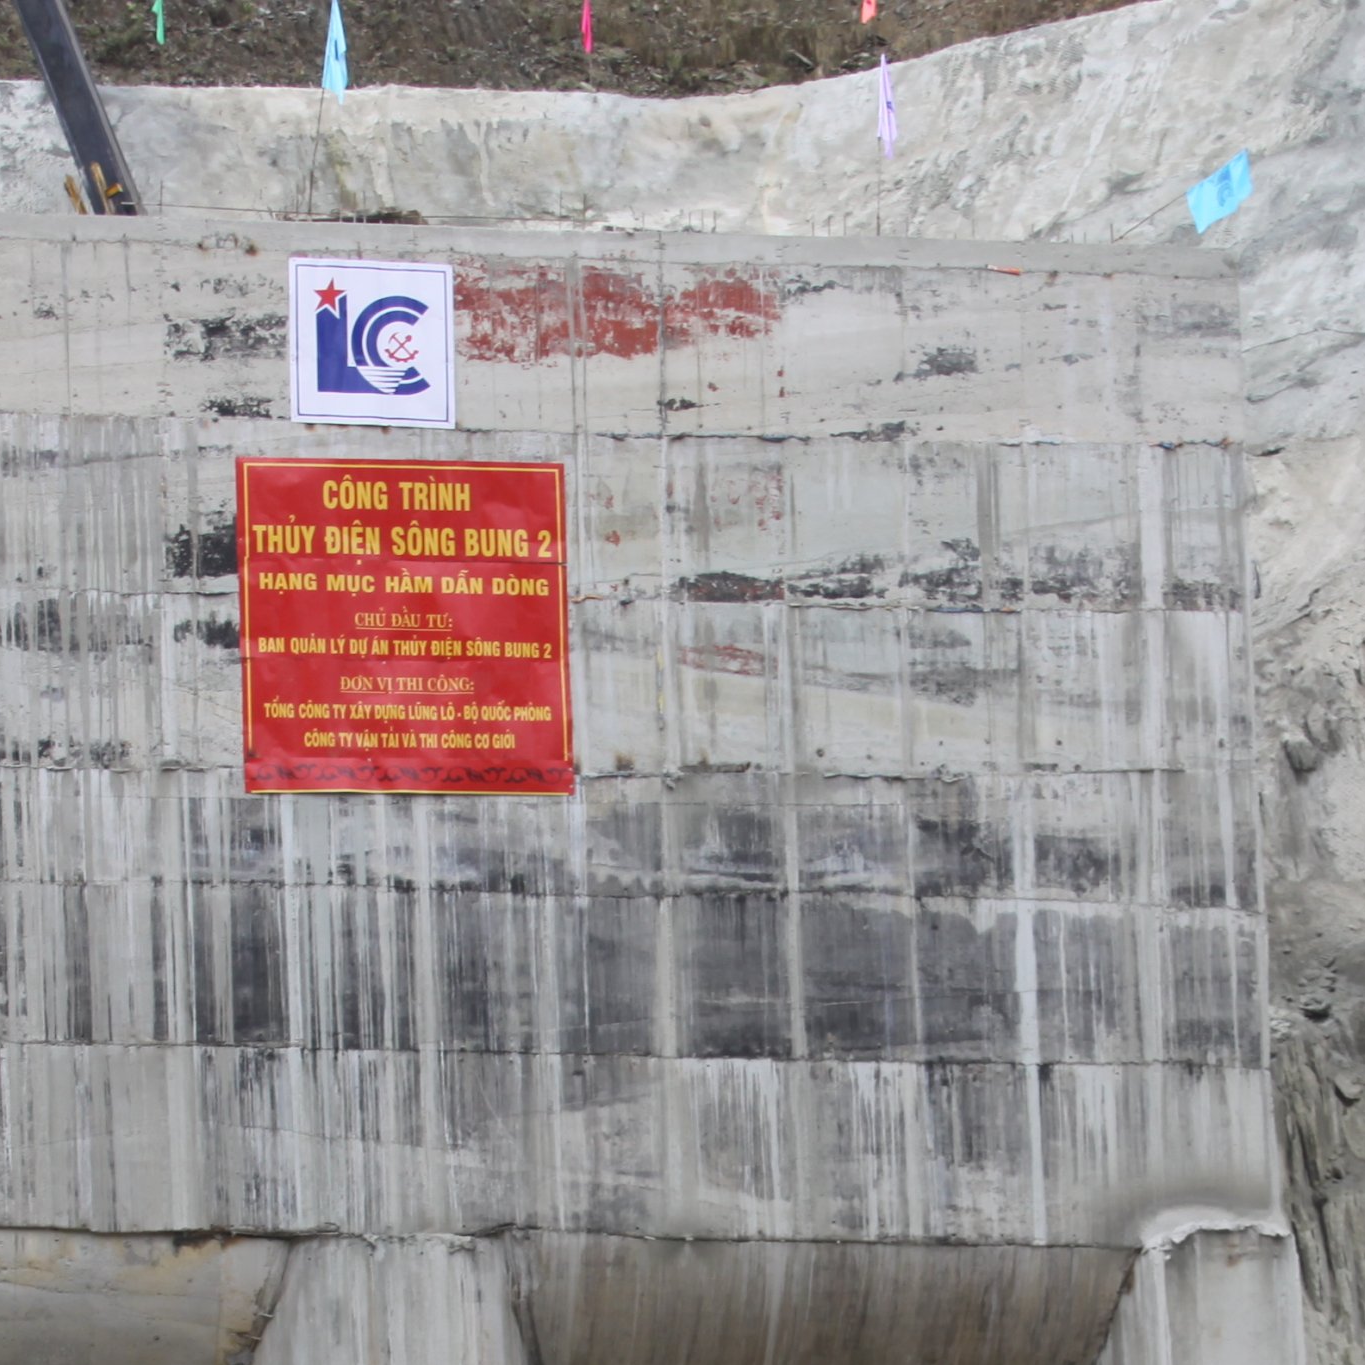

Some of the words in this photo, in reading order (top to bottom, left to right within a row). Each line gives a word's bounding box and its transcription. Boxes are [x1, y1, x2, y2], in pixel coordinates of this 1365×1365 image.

[322, 474, 388, 511] CÔNG
[399, 475, 471, 512] TRÌNH
[252, 514, 316, 554] THỦY
[324, 519, 381, 566] ĐIỆN
[391, 520, 456, 557] SÔNG
[464, 528, 529, 558] BUNG
[537, 529, 552, 559] 2
[259, 572, 318, 595] HẠNG
[326, 574, 375, 597] MỤC
[385, 567, 433, 594] HẦM
[440, 569, 484, 595] DẪN
[492, 573, 550, 597] DÒNG
[354, 607, 386, 628] CHỦ
[391, 605, 421, 629] ĐẦU
[426, 612, 453, 629] TƯ:
[258, 636, 285, 654] BAN
[290, 632, 327, 655] QUẢN
[330, 633, 346, 655] LÝ
[349, 637, 369, 659] DỰ
[371, 635, 389, 656] ÁN
[393, 634, 428, 656] THỦY
[431, 636, 462, 660] ĐIỆN
[466, 636, 501, 657] SÔNG
[504, 641, 540, 659] BUNG
[543, 643, 552, 660] 2
[340, 674, 374, 692] ĐƠN
[376, 676, 393, 694] VỊ
[396, 676, 424, 693] THI
[427, 674, 475, 694] CÔNG:
[264, 695, 295, 719] TỔNG
[299, 699, 330, 719] CÔNG
[333, 703, 347, 720] TY
[350, 701, 371, 720] XÂY
[440, 702, 455, 721] LÔ
[463, 701, 479, 725] BỘ
[481, 700, 512, 722] QUỐC
[514, 701, 552, 722] PHÒNG
[304, 728, 336, 748] CÔNG
[338, 732, 353, 748] TY
[419, 733, 438, 750] THI
[441, 730, 473, 750] CÔNG
[474, 731, 490, 750] CƠ
